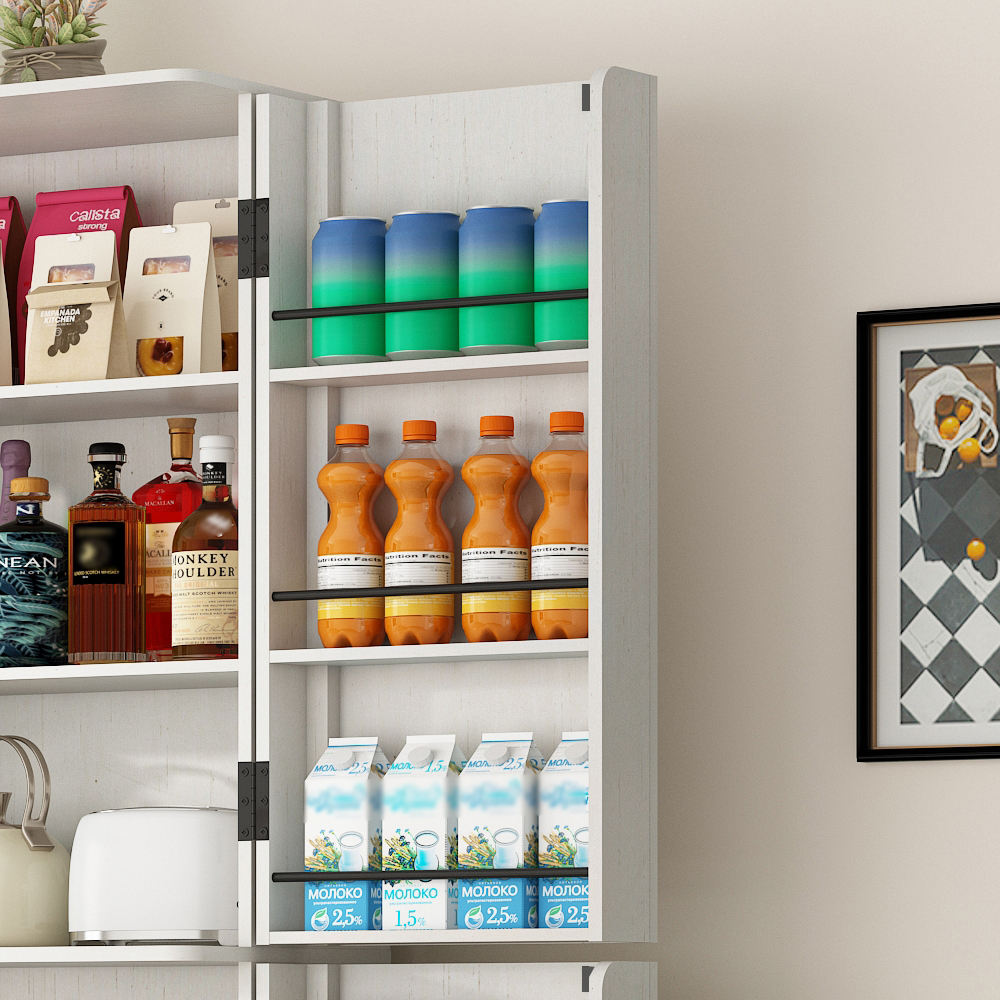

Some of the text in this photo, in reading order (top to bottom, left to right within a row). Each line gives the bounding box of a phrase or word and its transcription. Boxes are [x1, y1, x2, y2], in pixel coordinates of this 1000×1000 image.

[77, 222, 108, 231] strong
[40, 308, 81, 318] EMPANADA
[44, 315, 76, 324] KITCHEN
[308, 888, 363, 900] МОЛОКО
[384, 888, 439, 900] МОЛОКО
[462, 885, 519, 898] МОЛОКО
